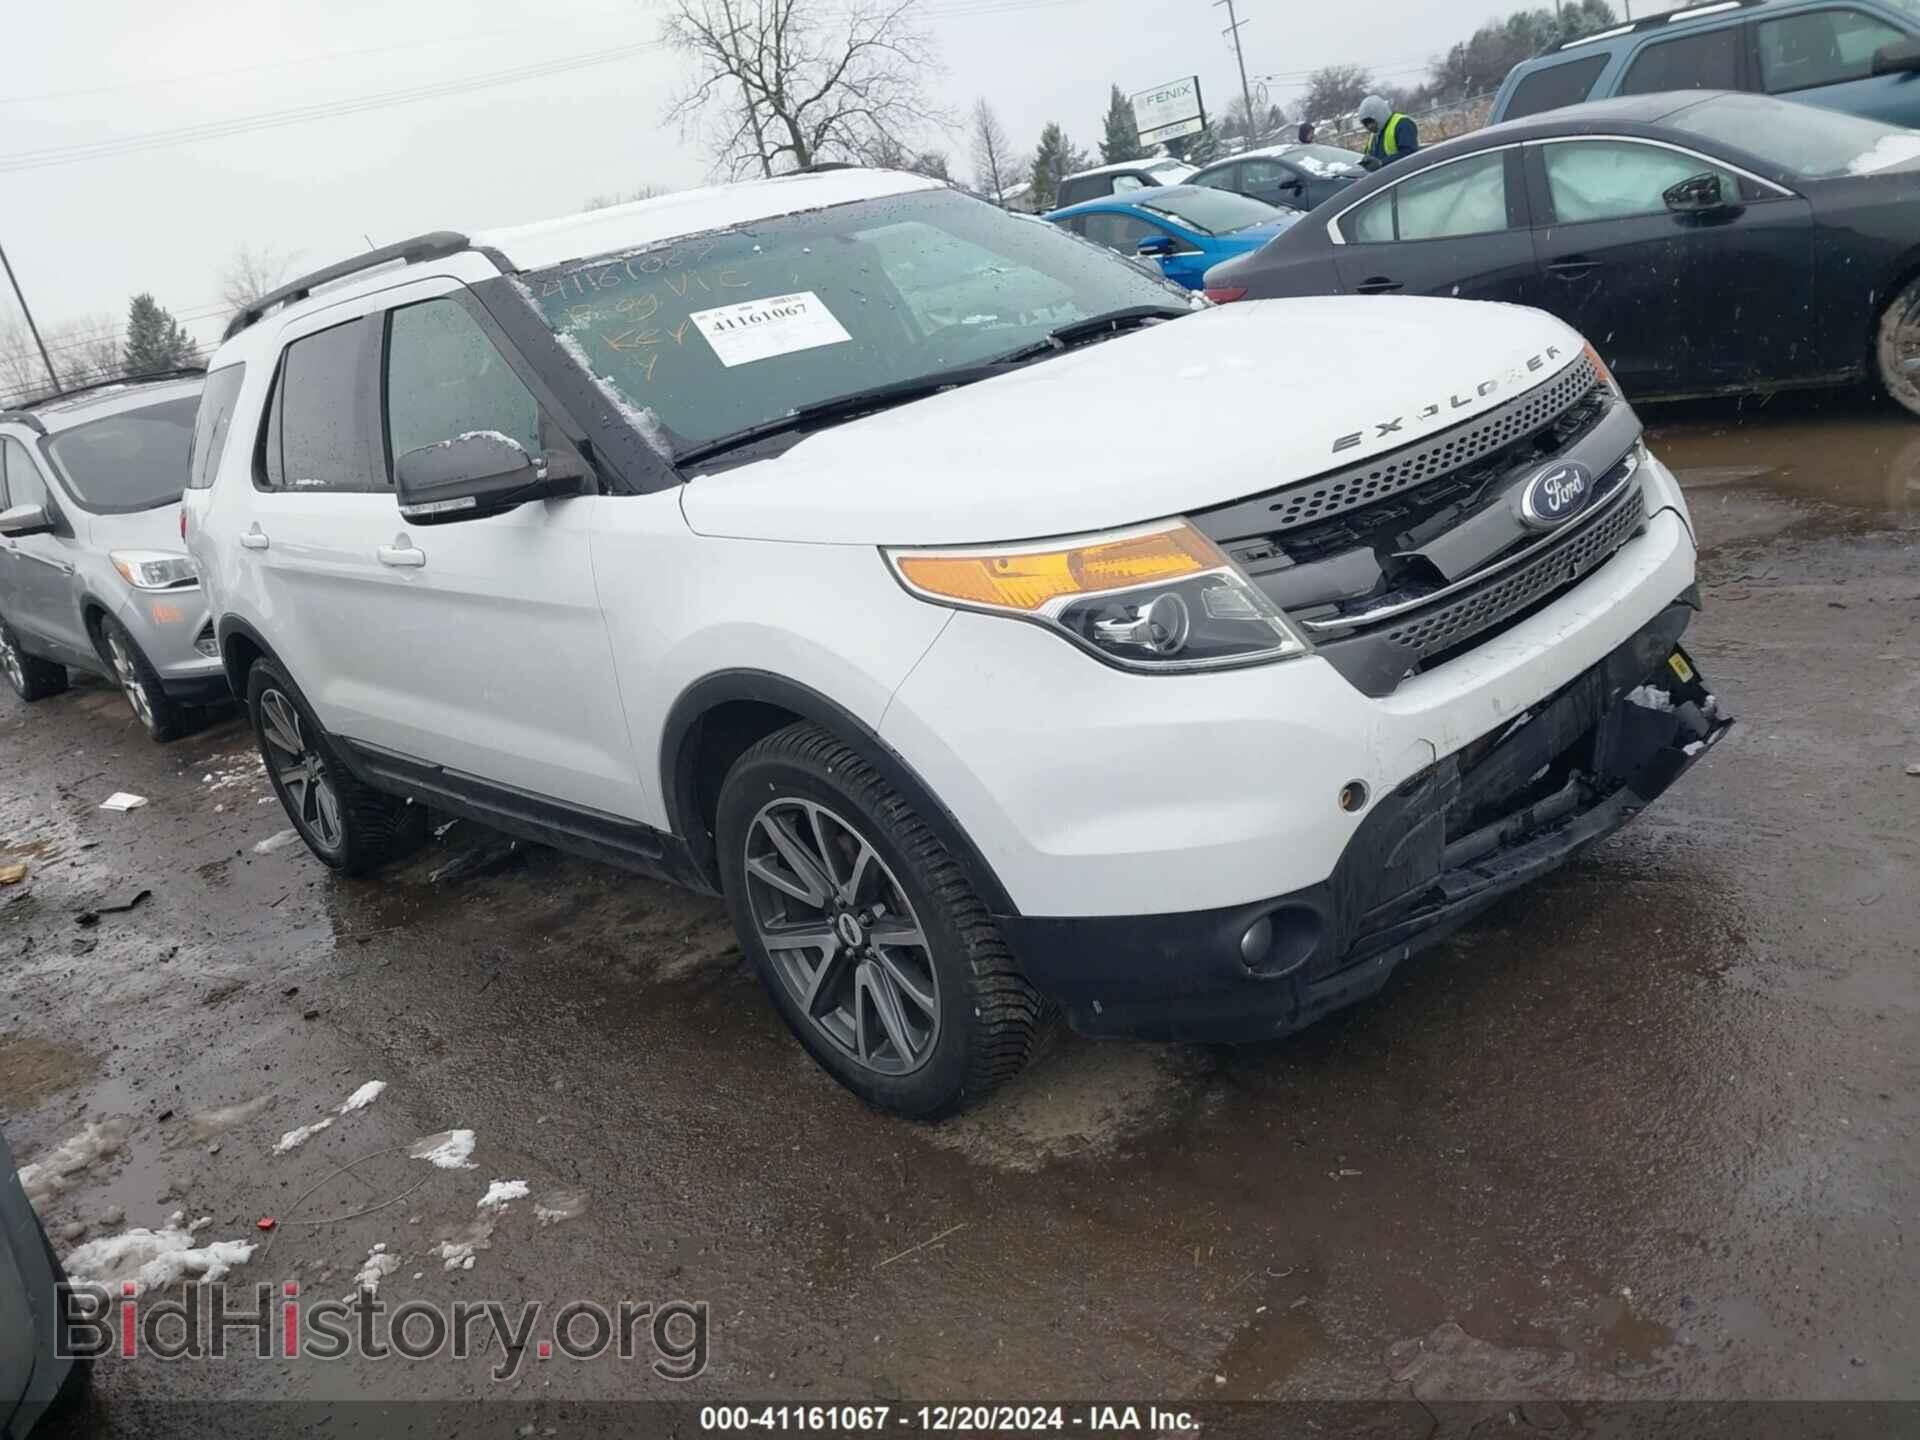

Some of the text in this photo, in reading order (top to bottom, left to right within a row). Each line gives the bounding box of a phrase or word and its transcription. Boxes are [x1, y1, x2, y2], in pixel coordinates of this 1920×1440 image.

[1146, 84, 1193, 104] FENIX
[713, 303, 808, 332] 41161067
[1331, 345, 1561, 453] EXPLOER
[1544, 468, 1585, 511] Ford
